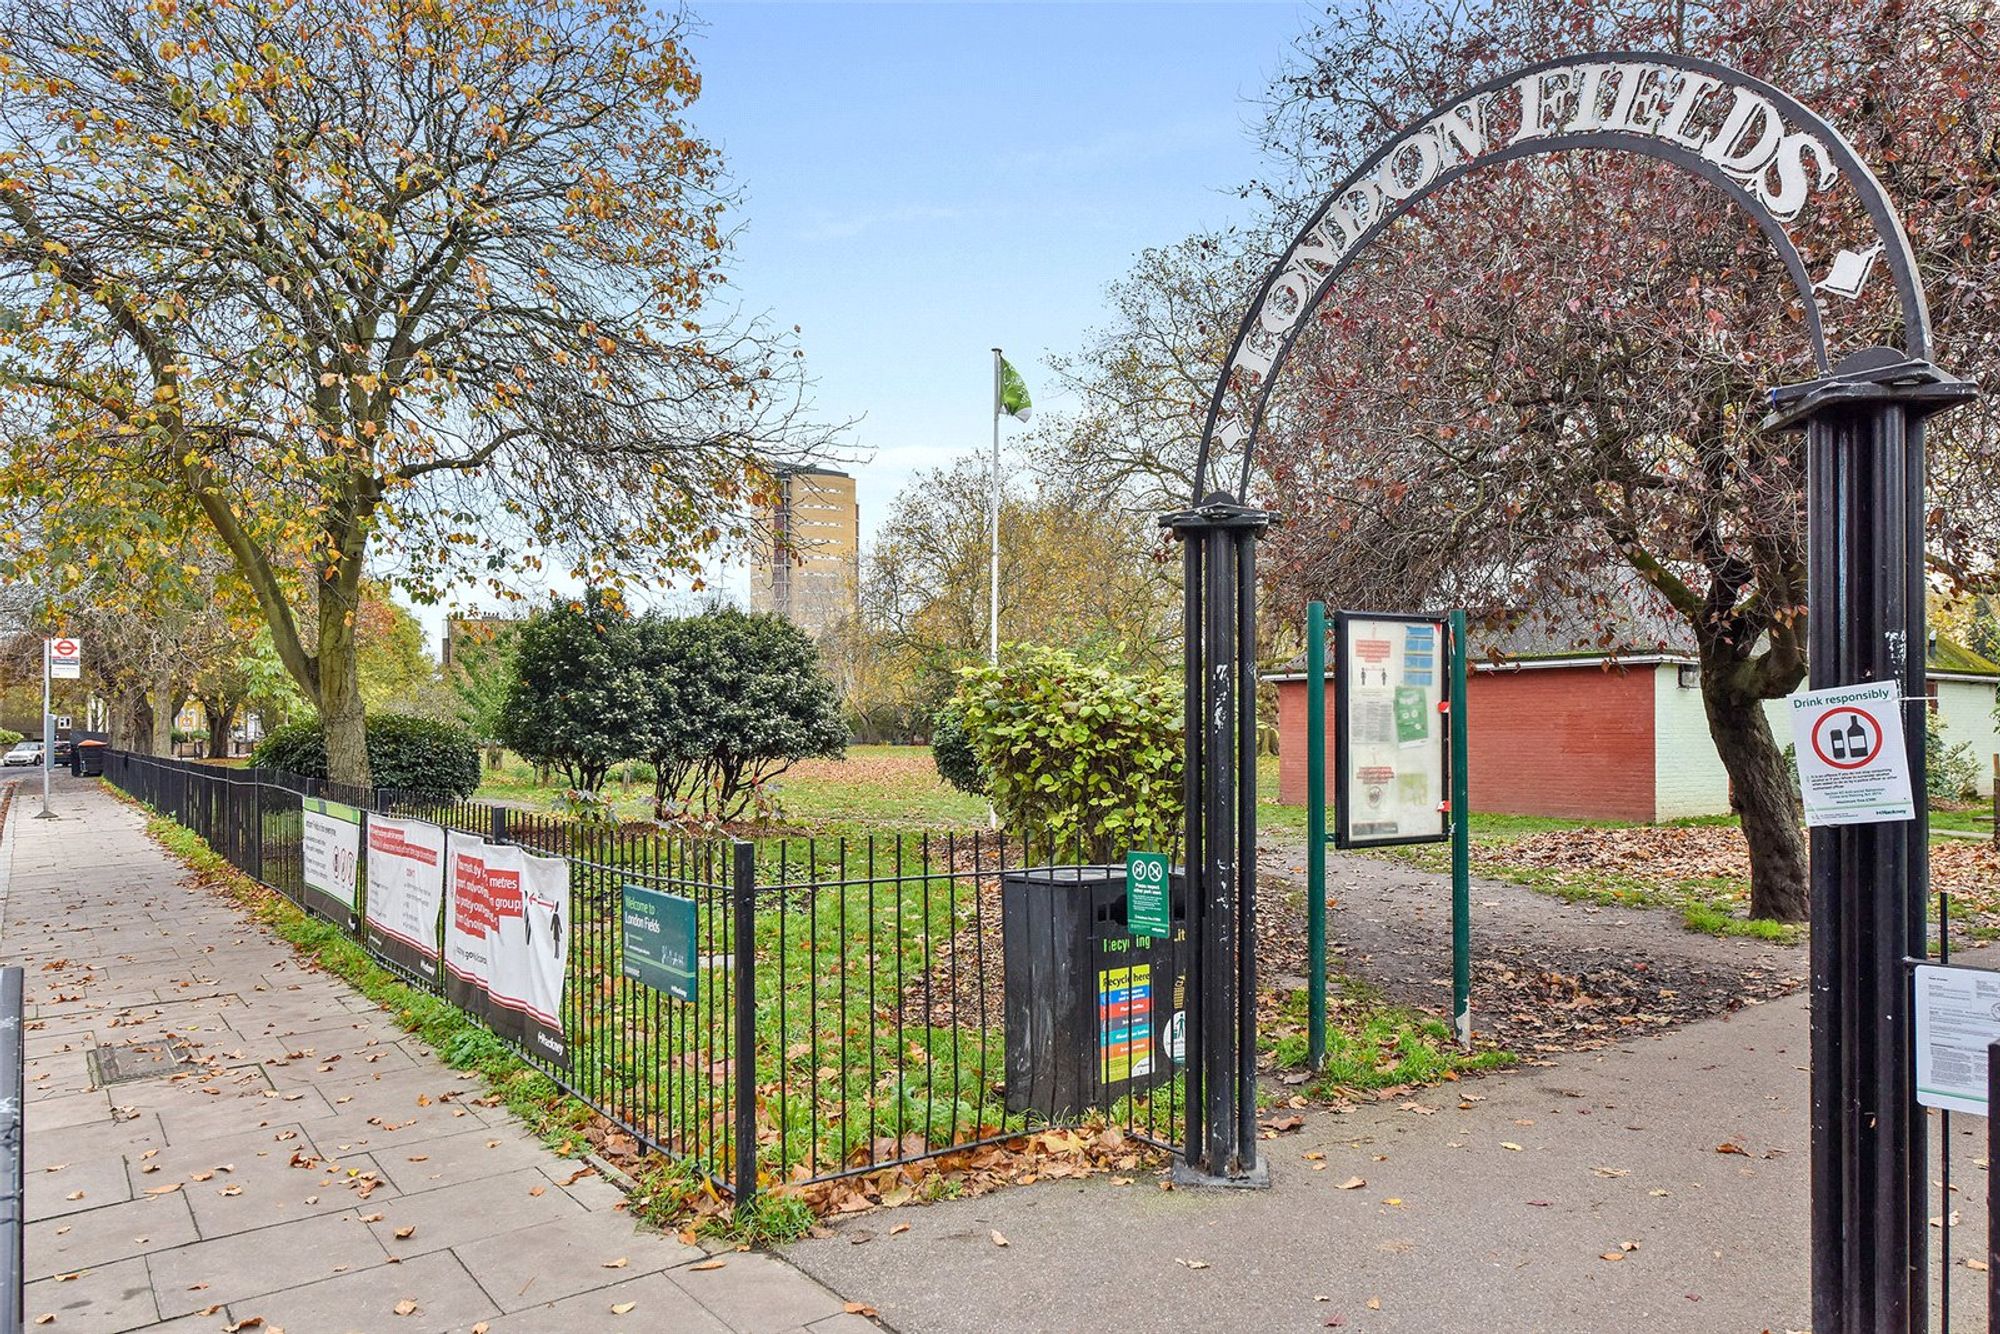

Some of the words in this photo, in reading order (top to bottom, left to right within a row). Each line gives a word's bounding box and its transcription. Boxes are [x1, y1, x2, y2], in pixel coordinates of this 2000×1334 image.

[1231, 91, 1497, 383] LONDON
[1508, 63, 1838, 223] FIELDS
[1794, 697, 1823, 709] Drink
[1826, 689, 1889, 705] responsibly
[489, 877, 518, 889] metres
[625, 895, 648, 914] Welcome
[625, 911, 644, 929] London
[644, 916, 660, 934] Fields
